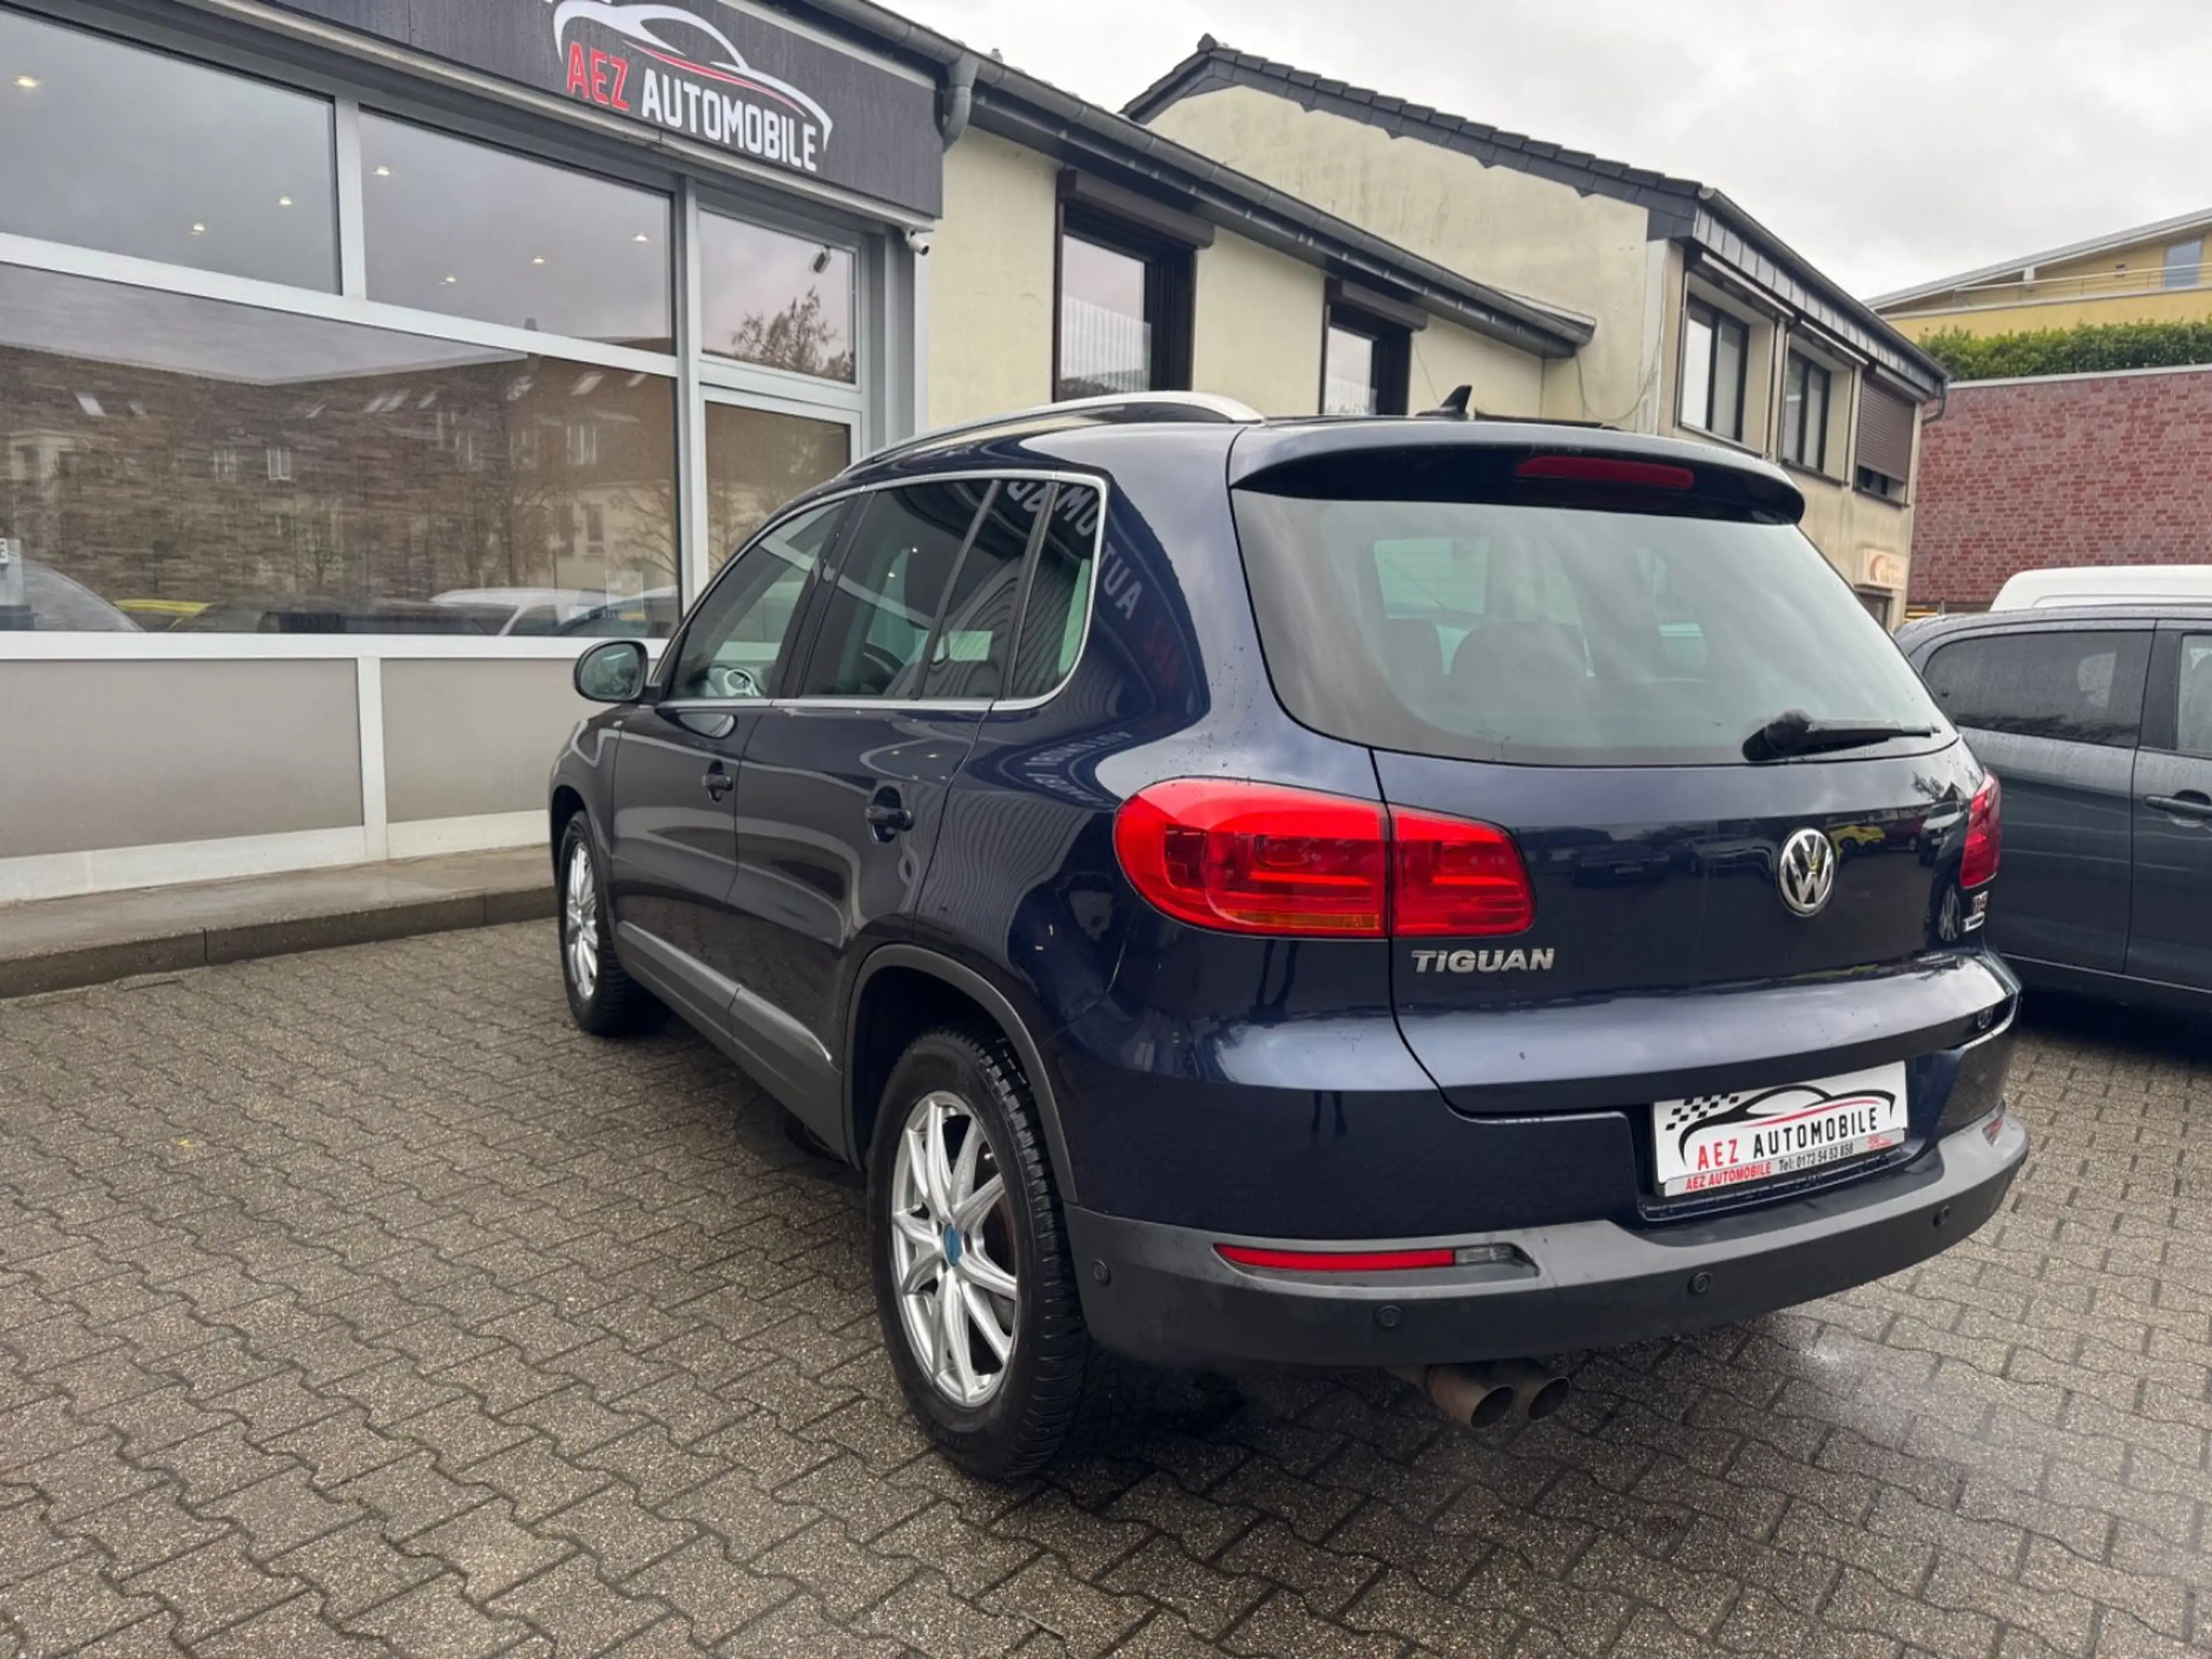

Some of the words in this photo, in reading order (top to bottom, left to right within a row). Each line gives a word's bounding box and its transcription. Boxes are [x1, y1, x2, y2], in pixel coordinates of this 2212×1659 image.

[566, 40, 630, 112] AEZ
[642, 67, 817, 172] AUTOMOBILE
[1411, 948, 1555, 974] TIGUAN
[1697, 1138, 1738, 1171] AEZ
[1753, 1107, 1877, 1158] AUTOMOBILE
[1685, 1175, 1705, 1191] AEZ
[1709, 1161, 1771, 1185] AUTOMOBILE
